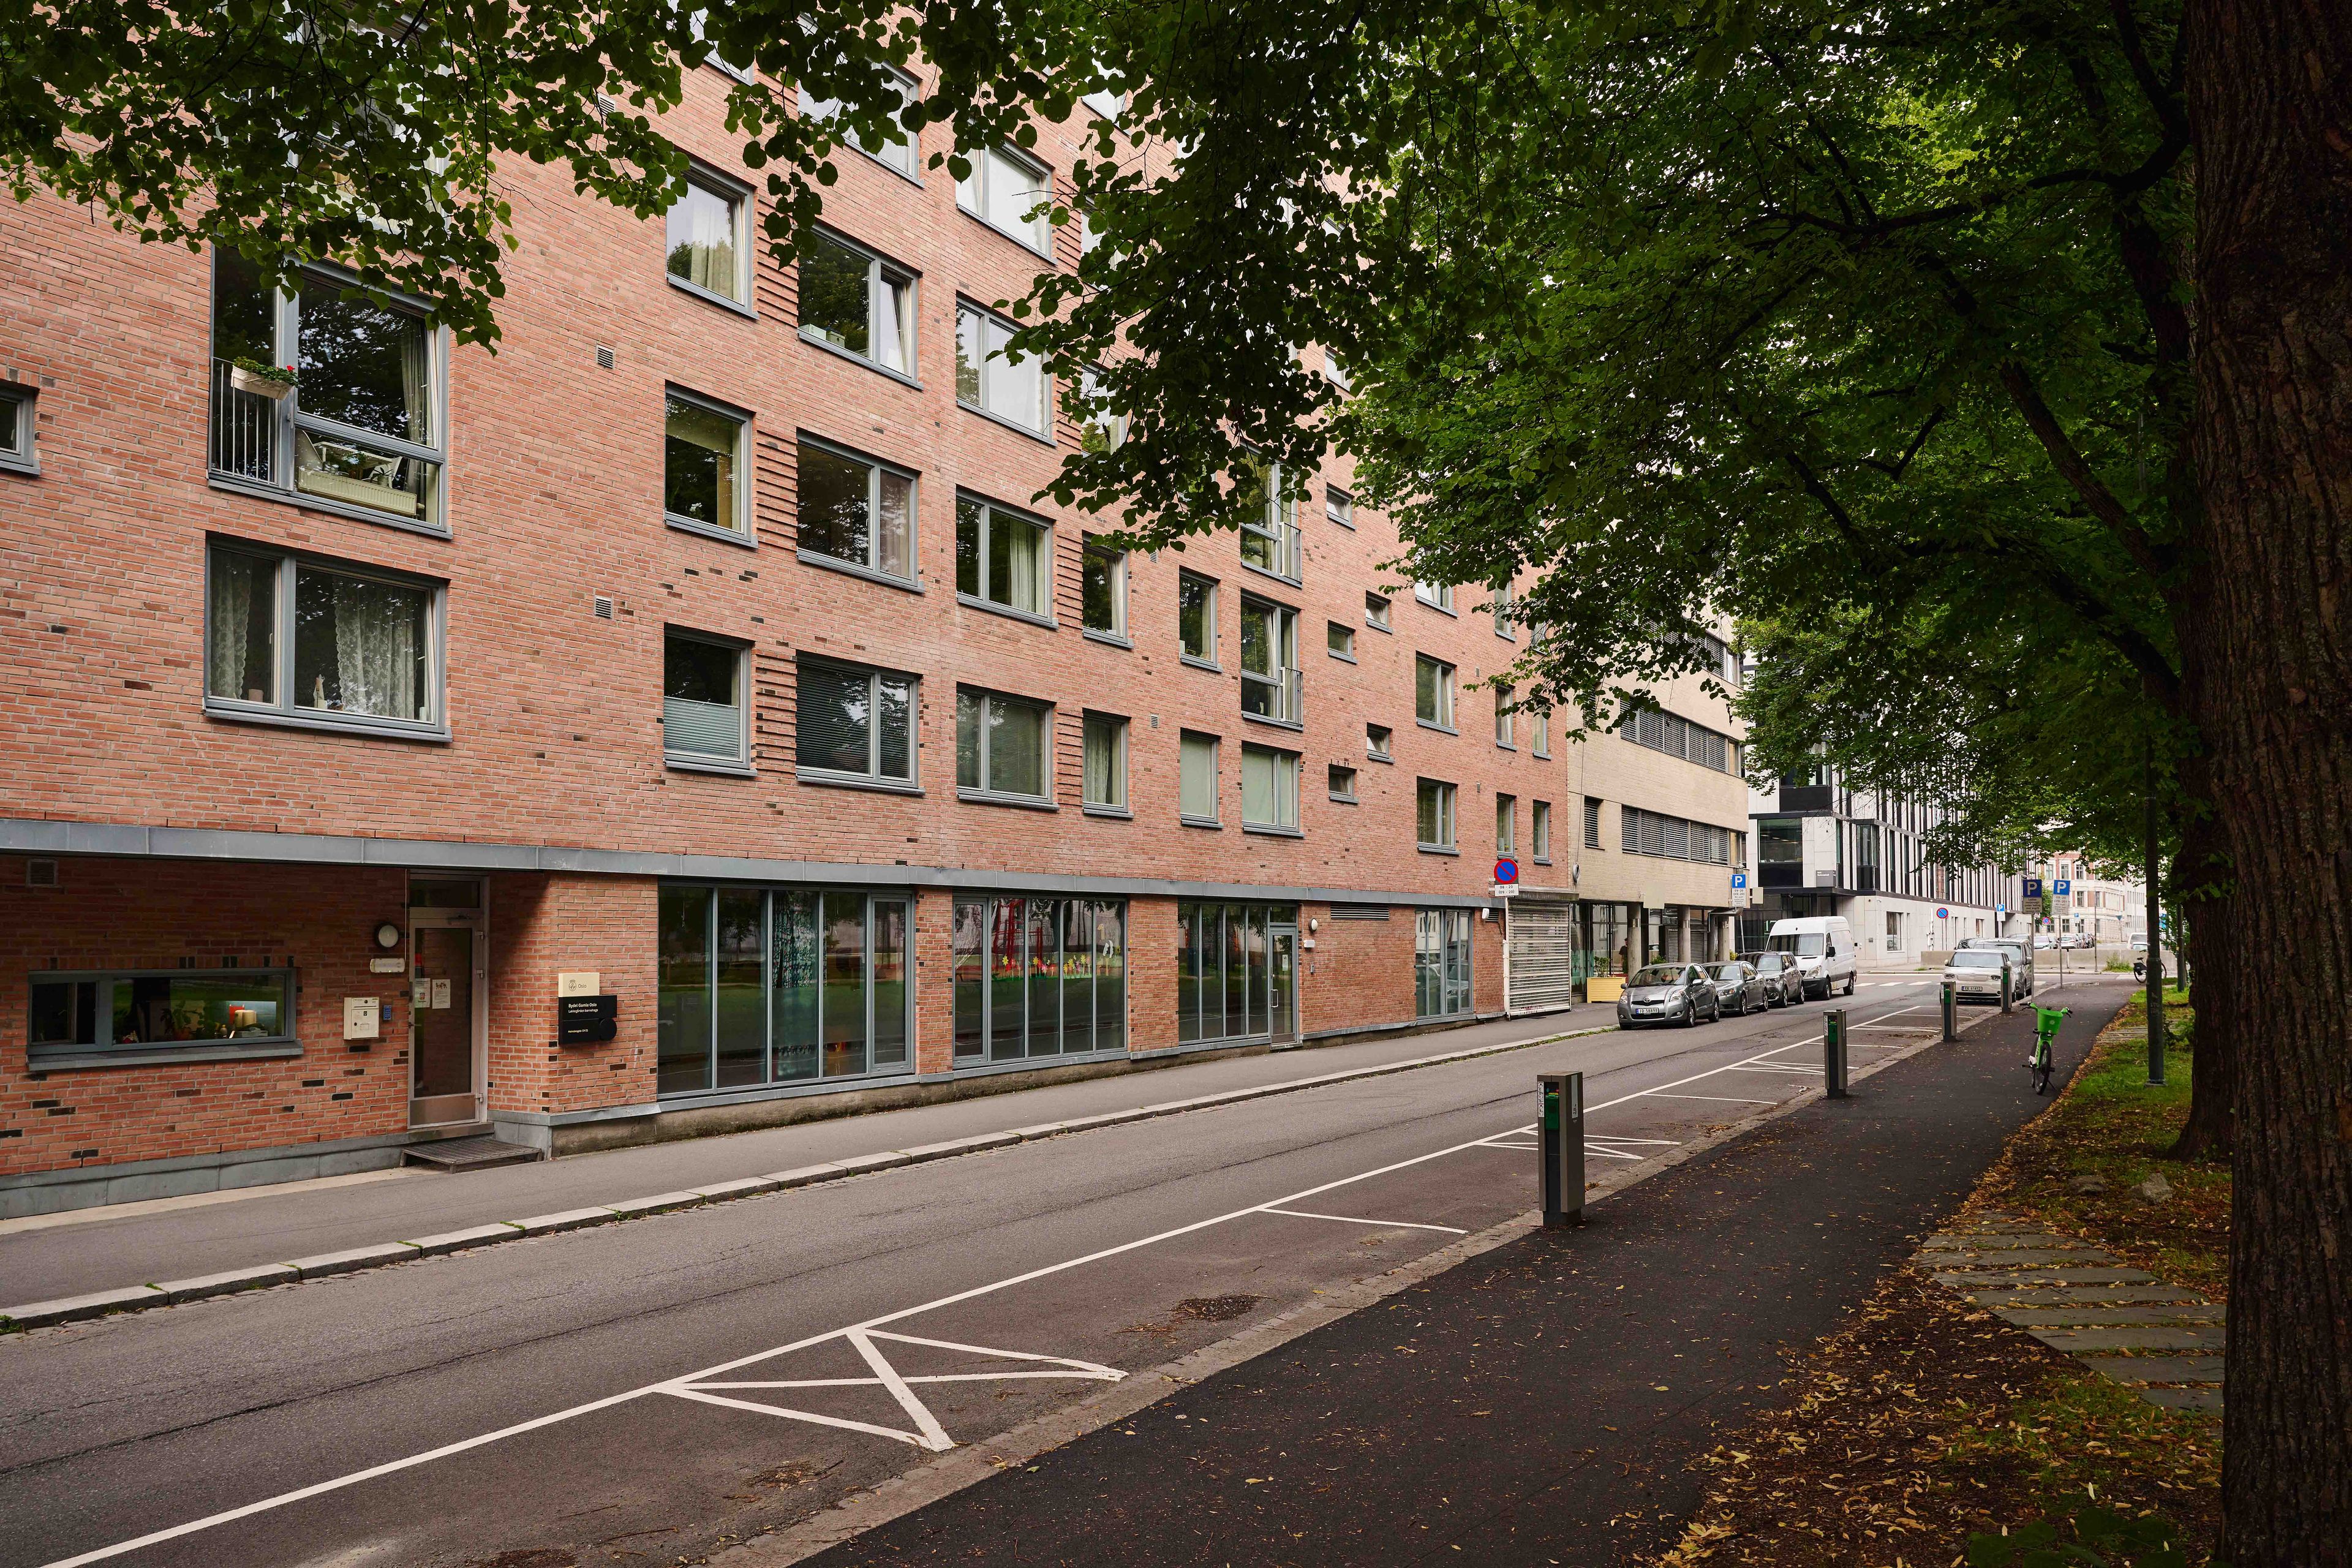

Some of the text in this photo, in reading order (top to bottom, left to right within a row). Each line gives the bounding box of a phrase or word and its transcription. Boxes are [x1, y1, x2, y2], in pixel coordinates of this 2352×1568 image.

[1735, 876, 1743, 887] P
[2057, 881, 2067, 893] P
[2027, 881, 2038, 895] P
